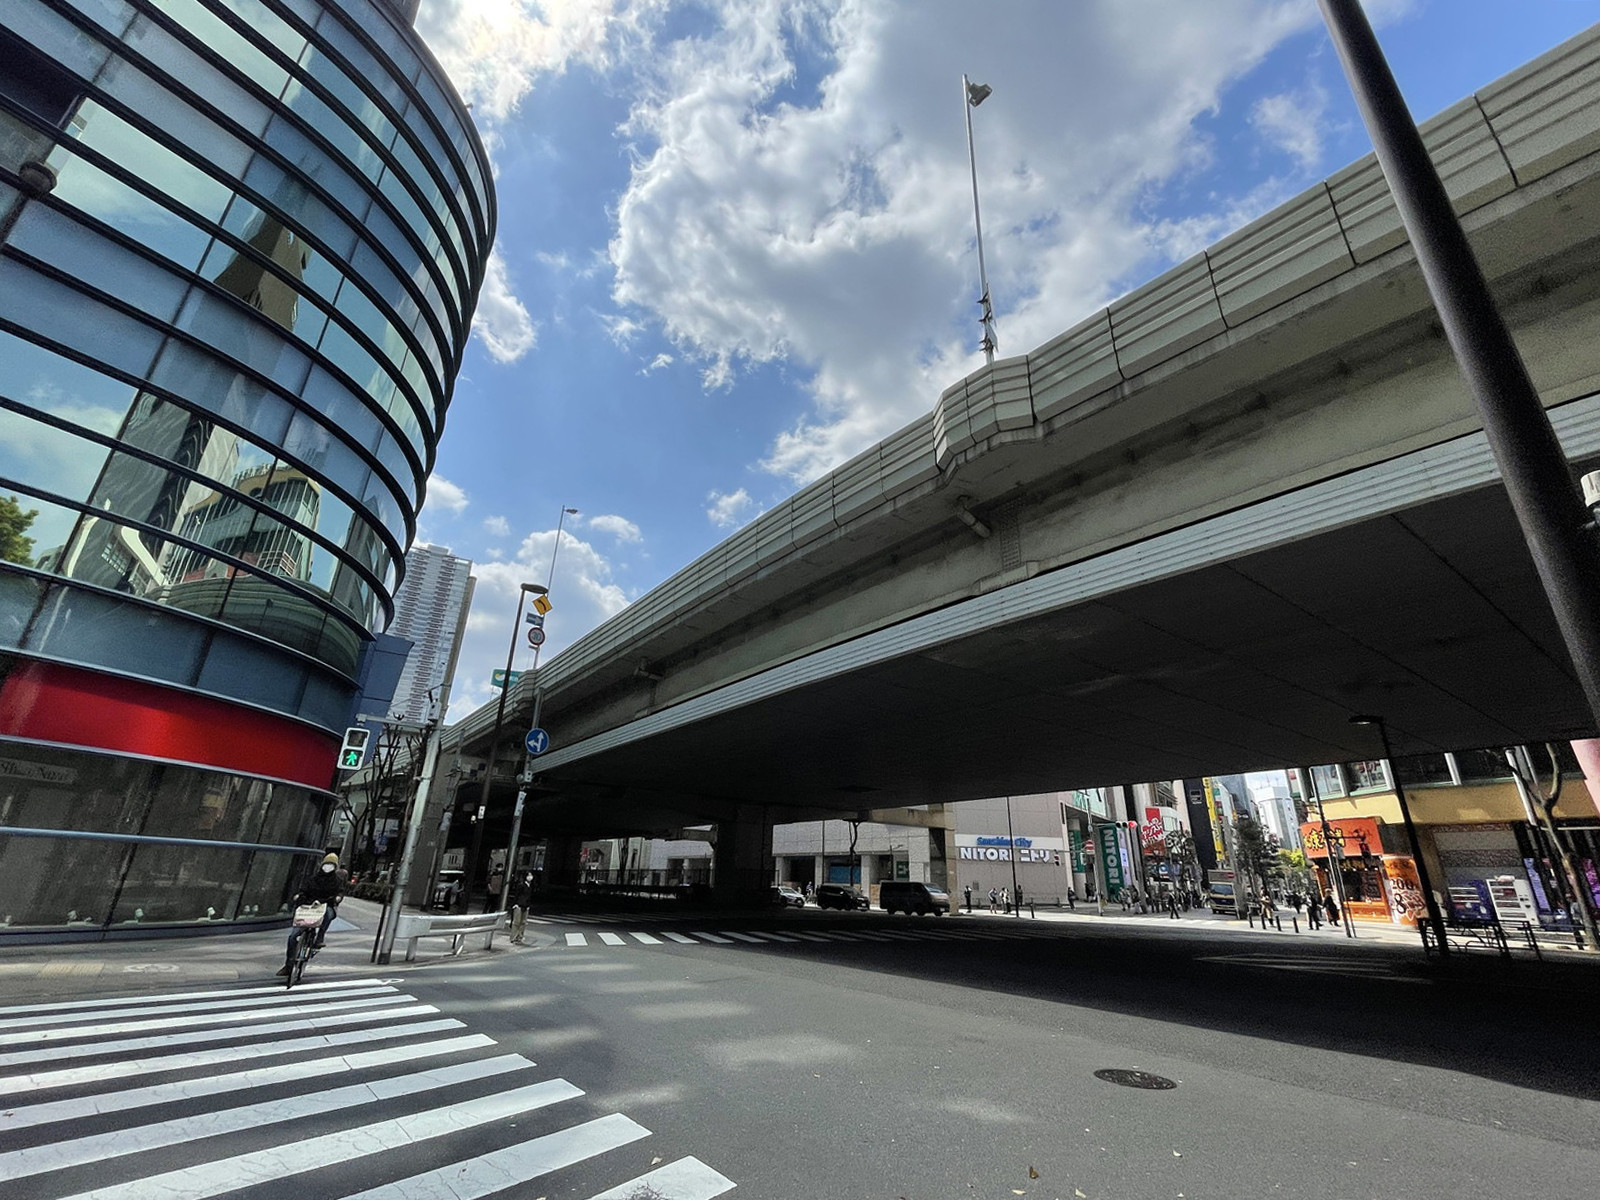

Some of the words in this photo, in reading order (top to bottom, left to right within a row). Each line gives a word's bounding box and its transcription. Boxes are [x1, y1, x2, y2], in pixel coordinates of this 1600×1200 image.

[960, 847, 1013, 861] NITORI
[1020, 849, 1050, 864] ニトリ
[1103, 829, 1120, 884] NITORI
